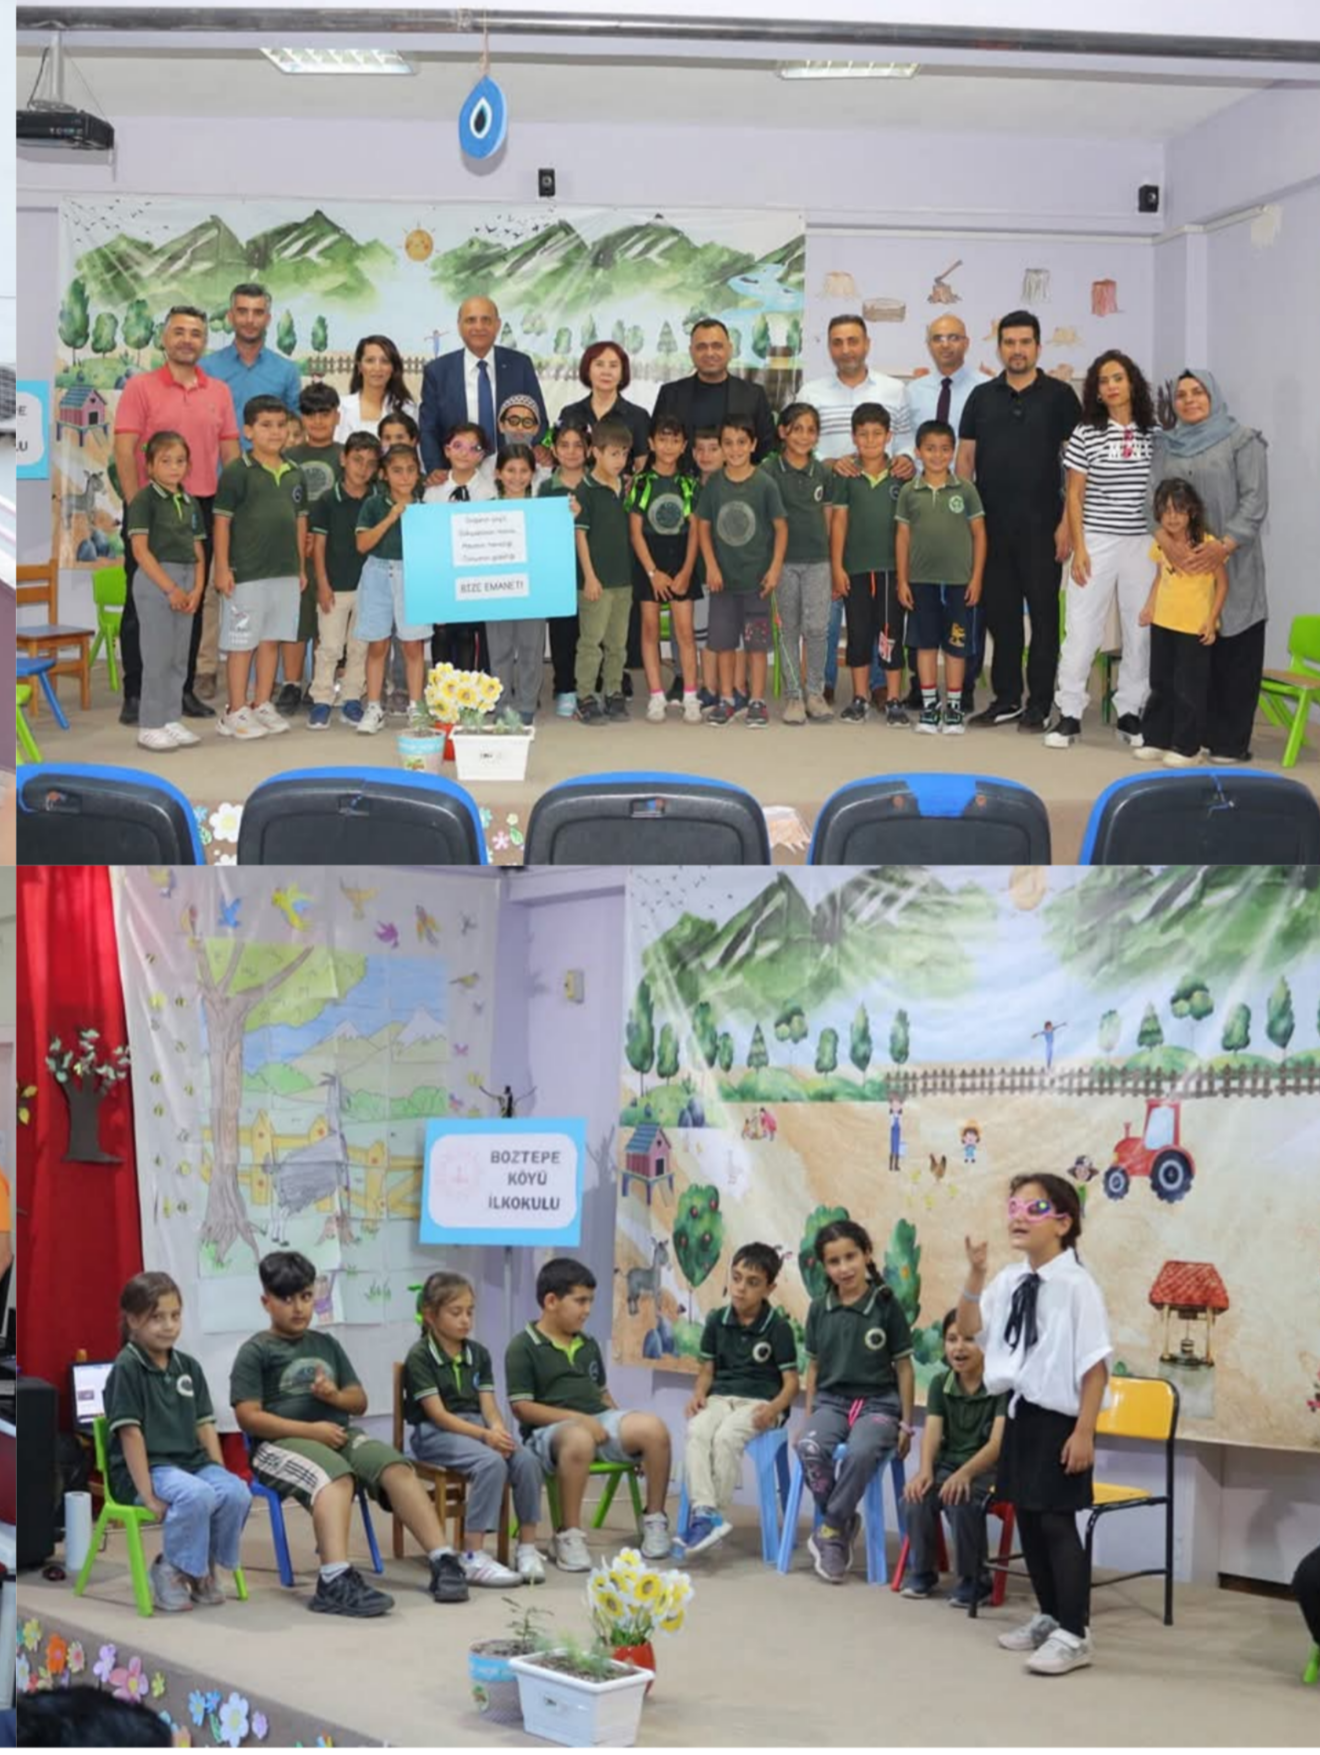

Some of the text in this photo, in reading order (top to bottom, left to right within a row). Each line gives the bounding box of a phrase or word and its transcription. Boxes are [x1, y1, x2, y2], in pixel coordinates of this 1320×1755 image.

[490, 1150, 561, 1164] BOZTEPE
[507, 1169, 547, 1186] KÖYÜ
[488, 1192, 560, 1211] İLKOKULU
